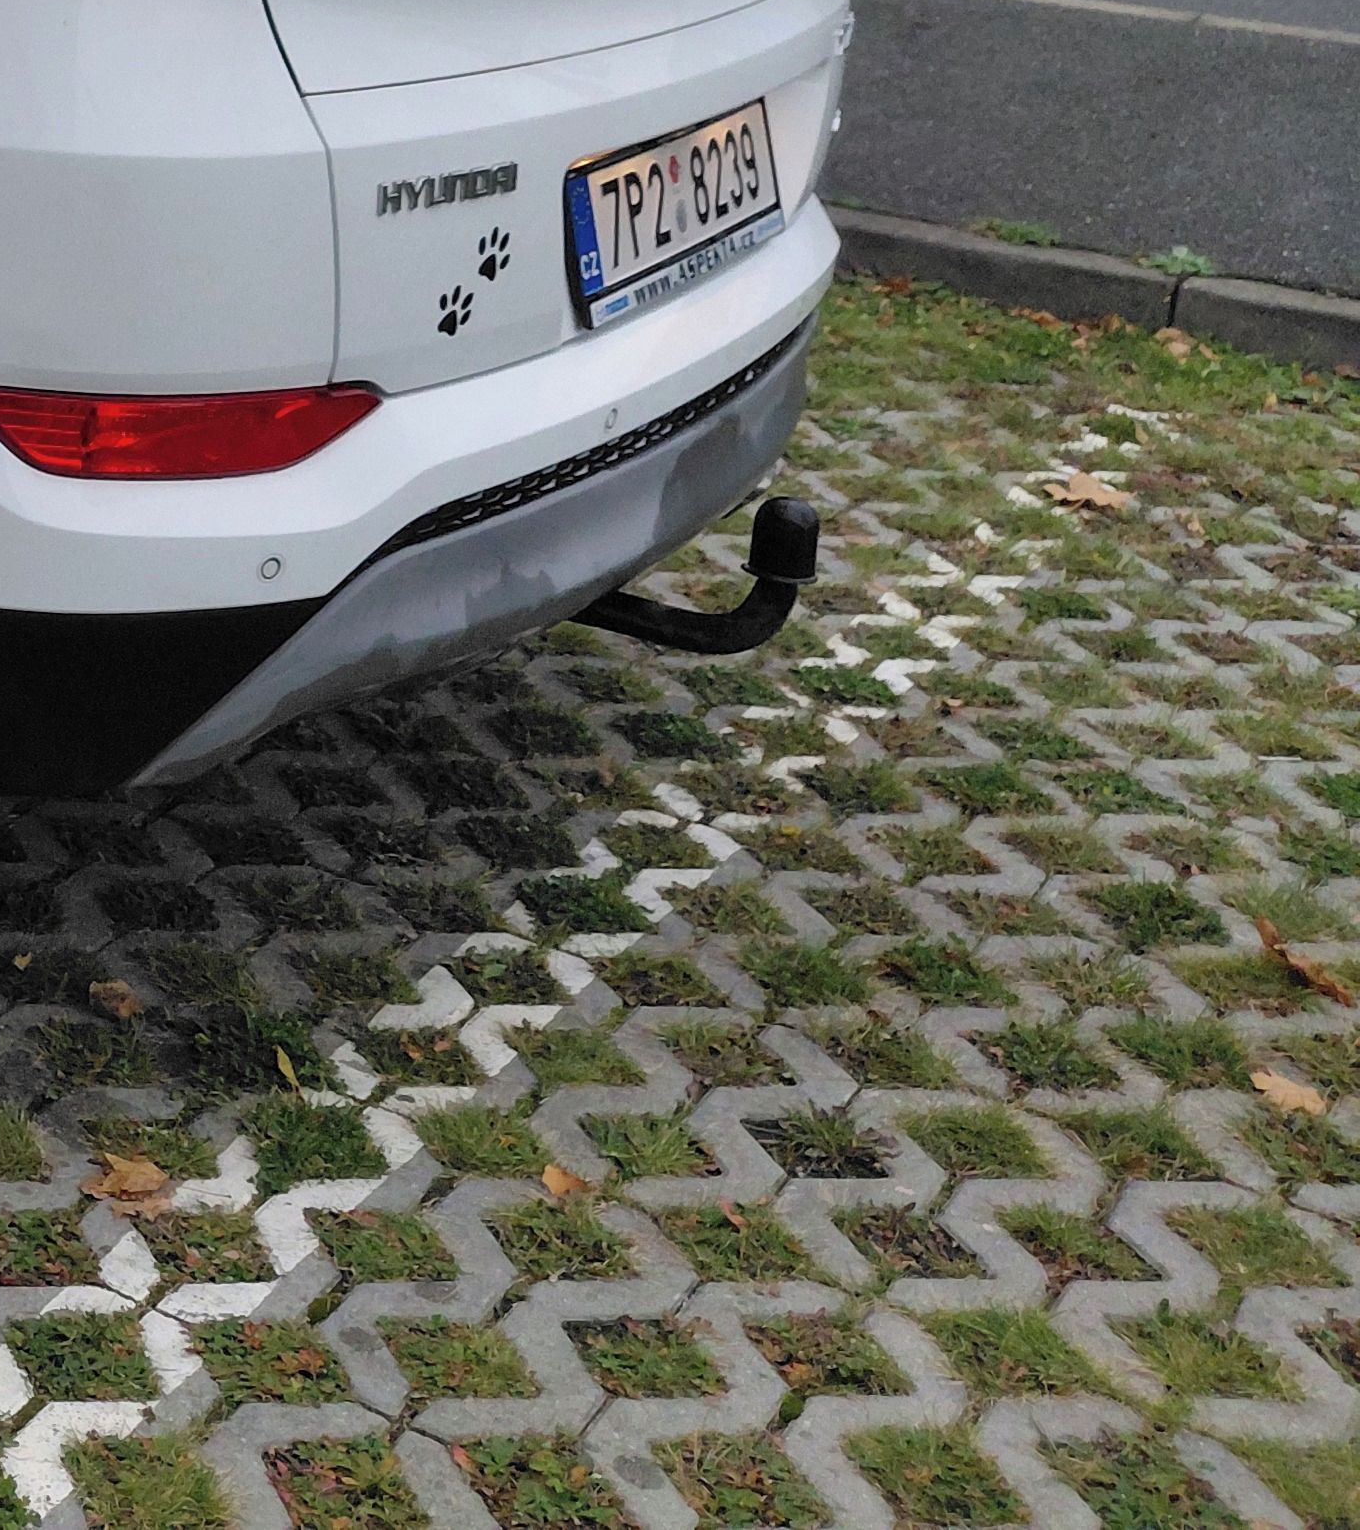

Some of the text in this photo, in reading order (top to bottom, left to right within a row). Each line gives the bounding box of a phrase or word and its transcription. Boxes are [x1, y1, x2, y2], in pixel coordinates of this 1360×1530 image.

[600, 122, 761, 270] 7P2 8239
[581, 251, 600, 282] CZ
